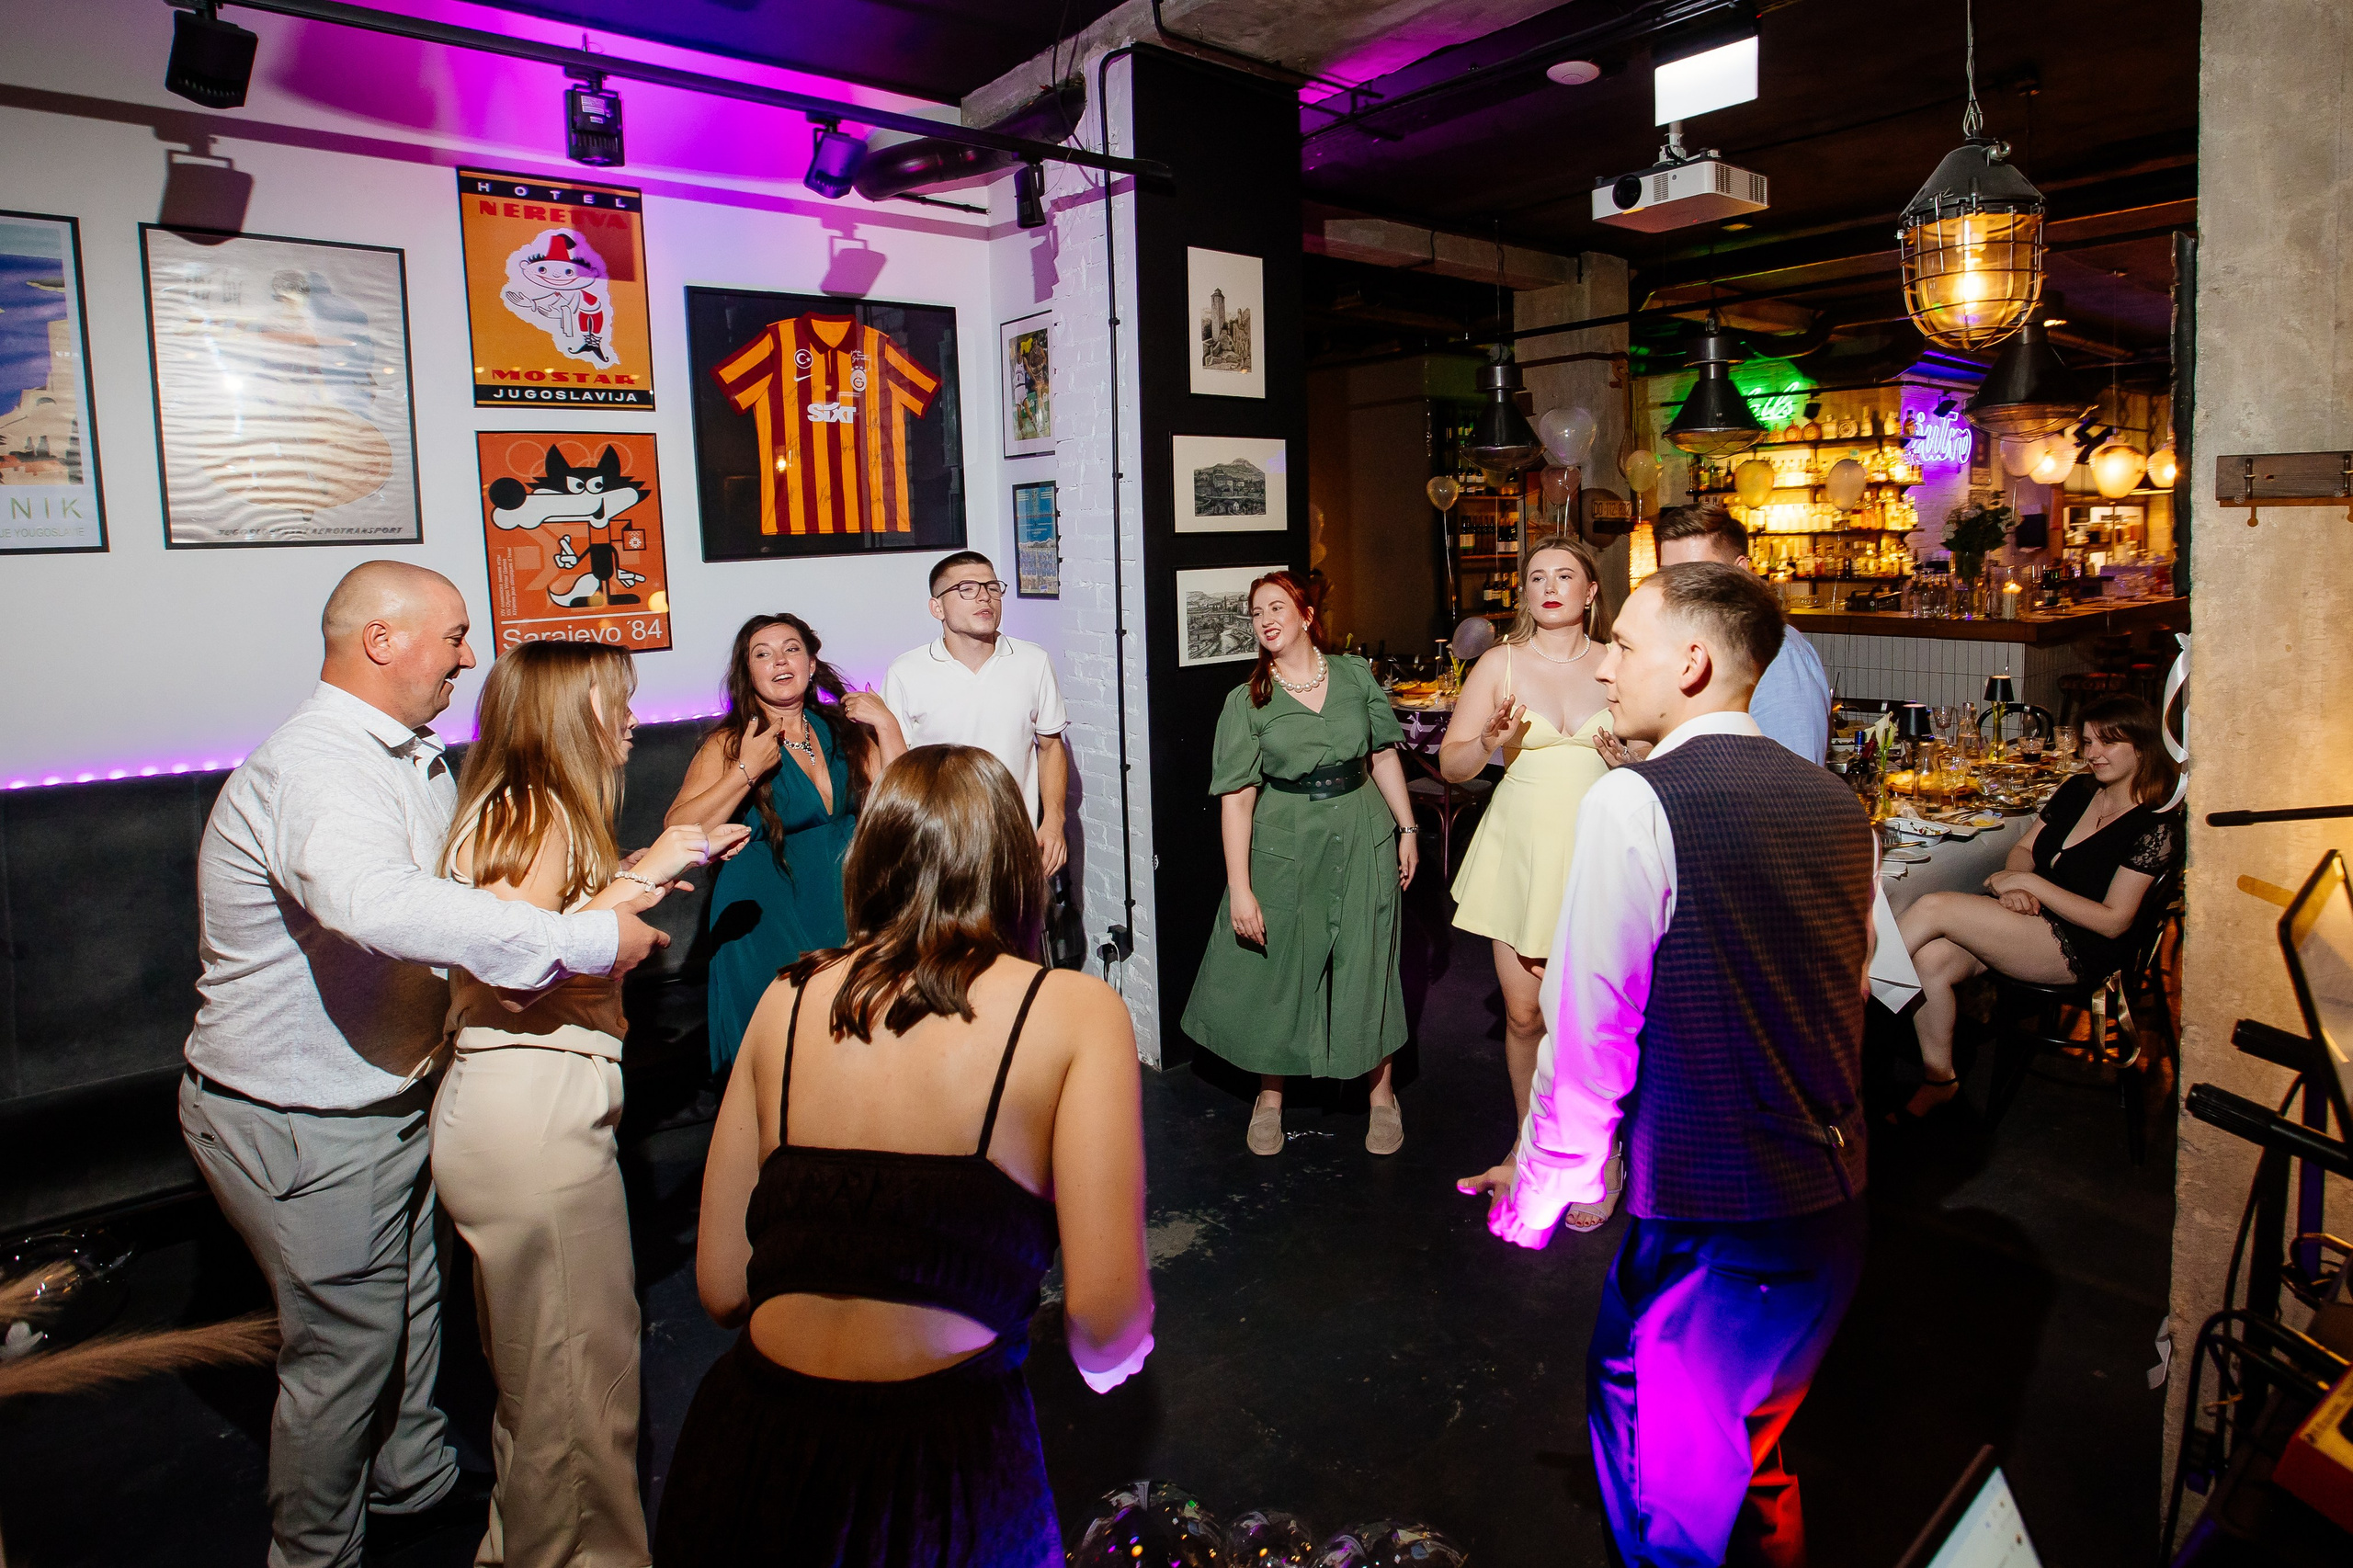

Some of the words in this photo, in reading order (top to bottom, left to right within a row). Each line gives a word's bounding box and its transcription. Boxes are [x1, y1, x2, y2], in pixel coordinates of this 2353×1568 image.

[477, 181, 628, 209] HOTEL
[479, 200, 629, 230] NERETVA
[492, 369, 636, 386] MOSTAR
[493, 387, 638, 403] JUGOSLAVIJA
[15, 527, 85, 538] YOUGOSLAE
[312, 527, 403, 535] AEROTRANSPORT
